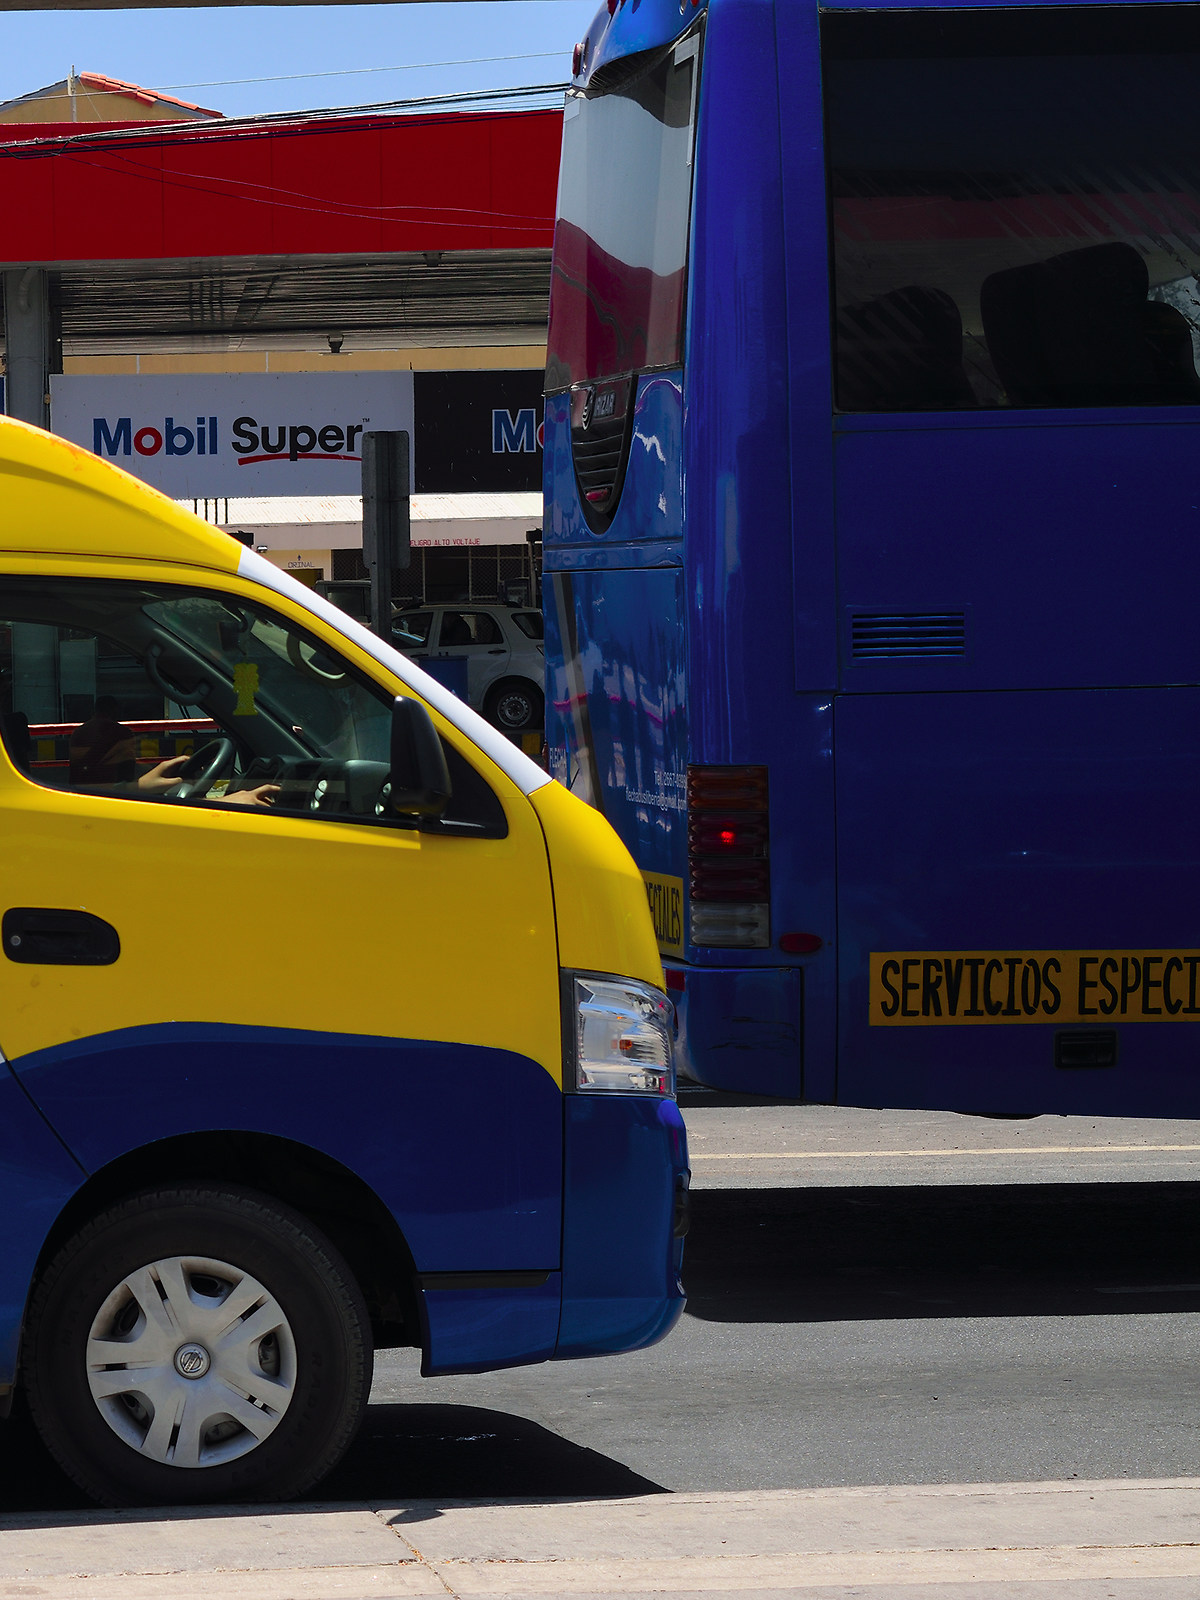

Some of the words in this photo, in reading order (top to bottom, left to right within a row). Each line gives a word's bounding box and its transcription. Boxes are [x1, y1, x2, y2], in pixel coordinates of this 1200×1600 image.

[93, 416, 218, 456] Mobil
[231, 416, 363, 461] Super
[434, 538, 450, 546] ALTO
[452, 537, 481, 546] VOLTAJE
[880, 957, 1062, 1017] SERVICIOS
[1077, 956, 1200, 1015] ESPECI
